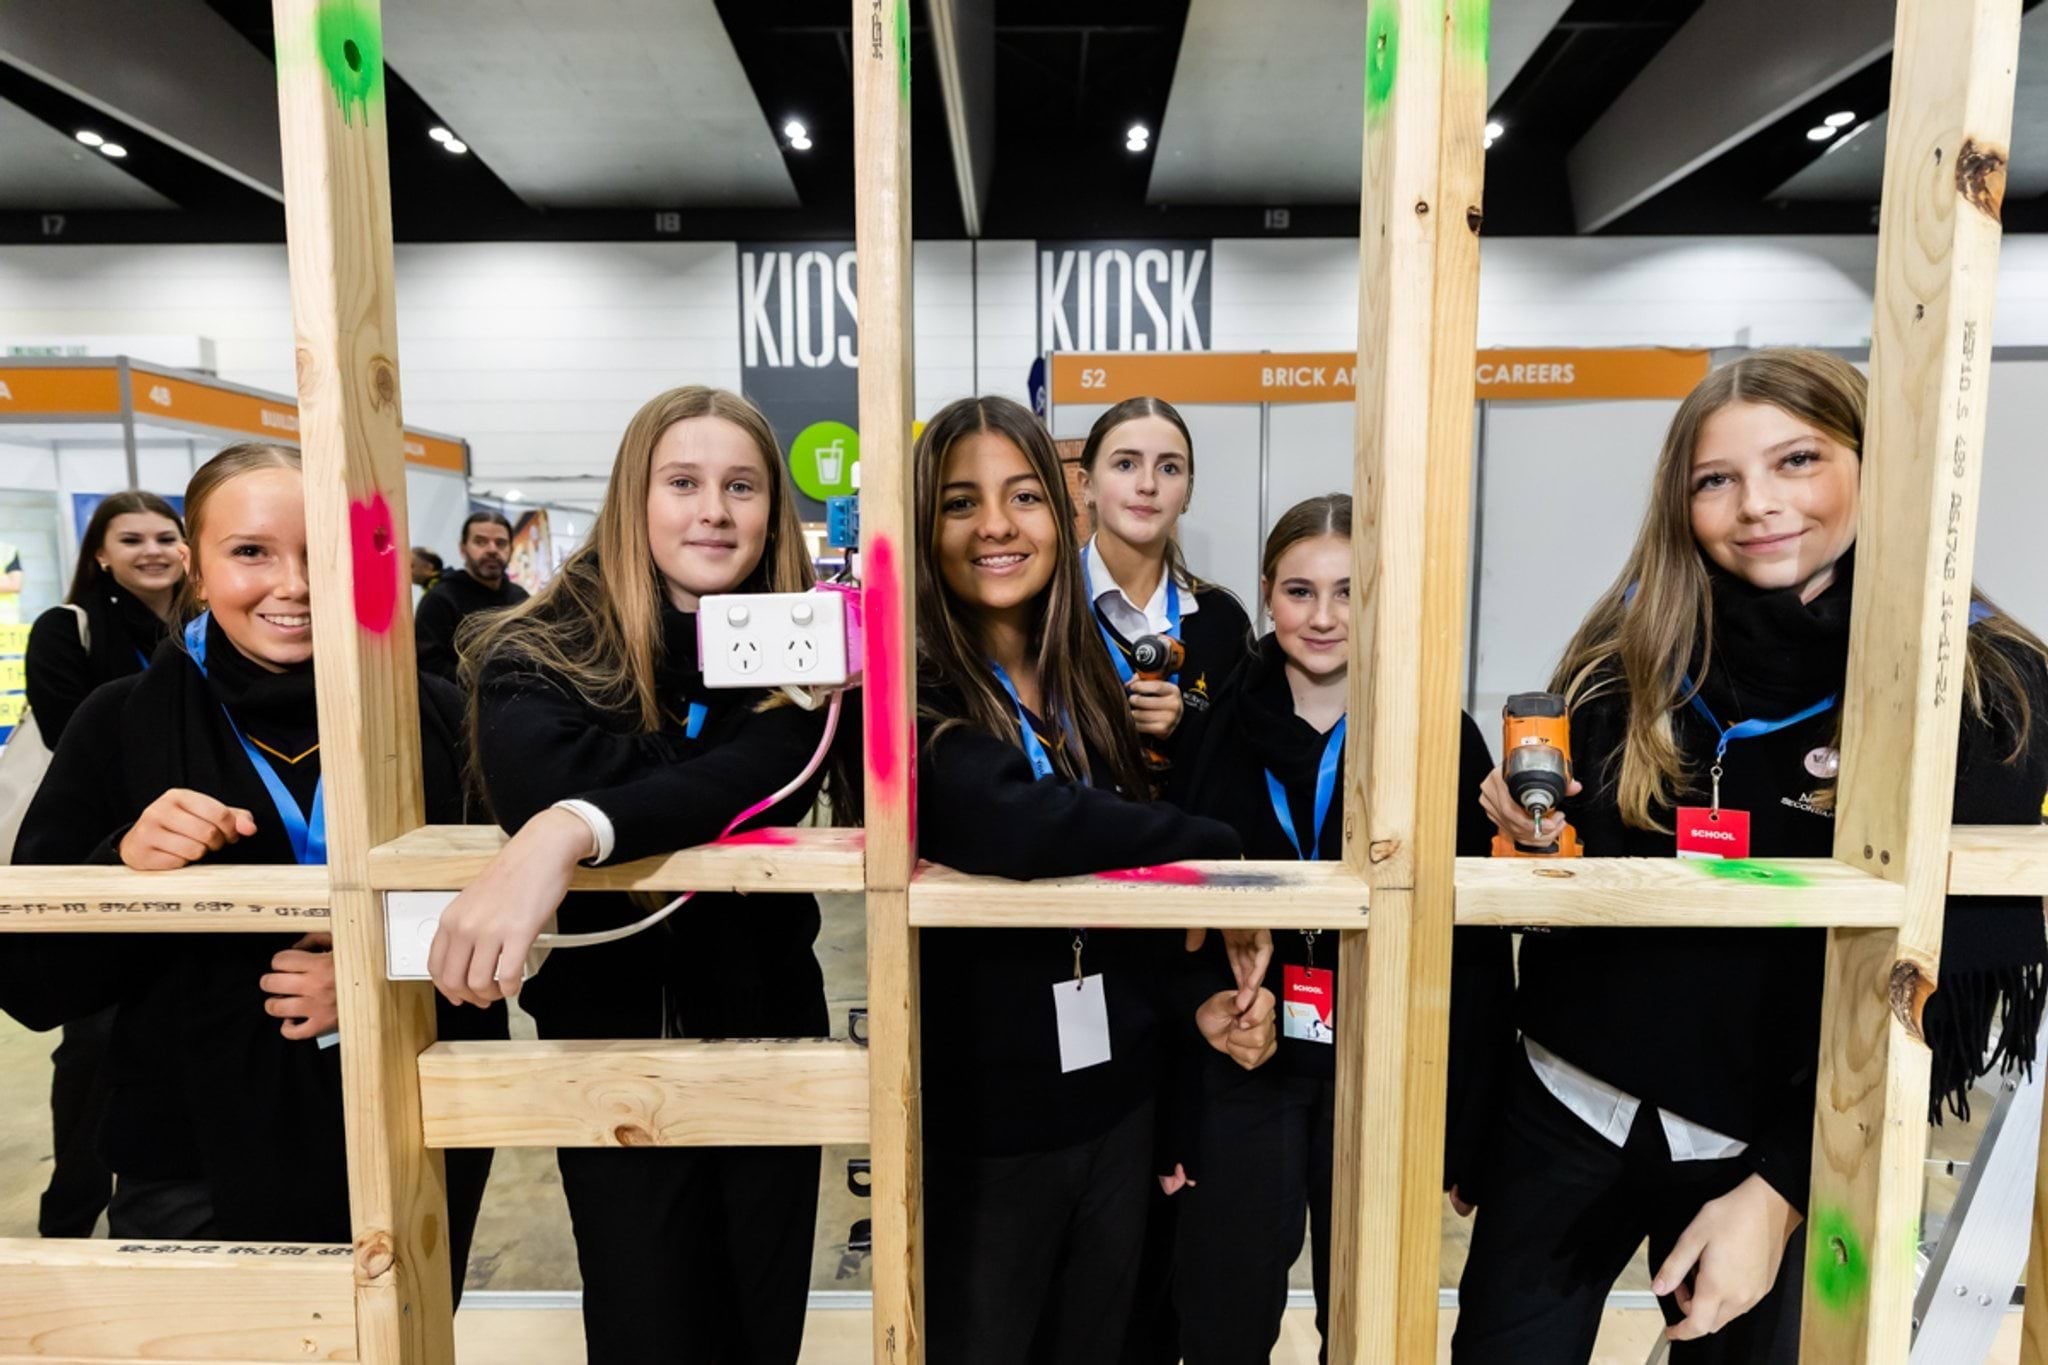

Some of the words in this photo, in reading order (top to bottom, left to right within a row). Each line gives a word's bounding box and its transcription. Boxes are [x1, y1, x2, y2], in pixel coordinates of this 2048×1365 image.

[42, 213, 65, 235] 17
[655, 211, 681, 232] 18
[1265, 209, 1290, 229] 19
[742, 251, 859, 368] KIOS
[1041, 249, 1206, 351] KIOSK
[1081, 368, 1107, 388] 52
[1262, 367, 1326, 387] BRICK
[1476, 363, 1575, 384] CAREERS
[1691, 828, 1737, 841] SCHOOL
[1292, 983, 1324, 995] SCHOOL
